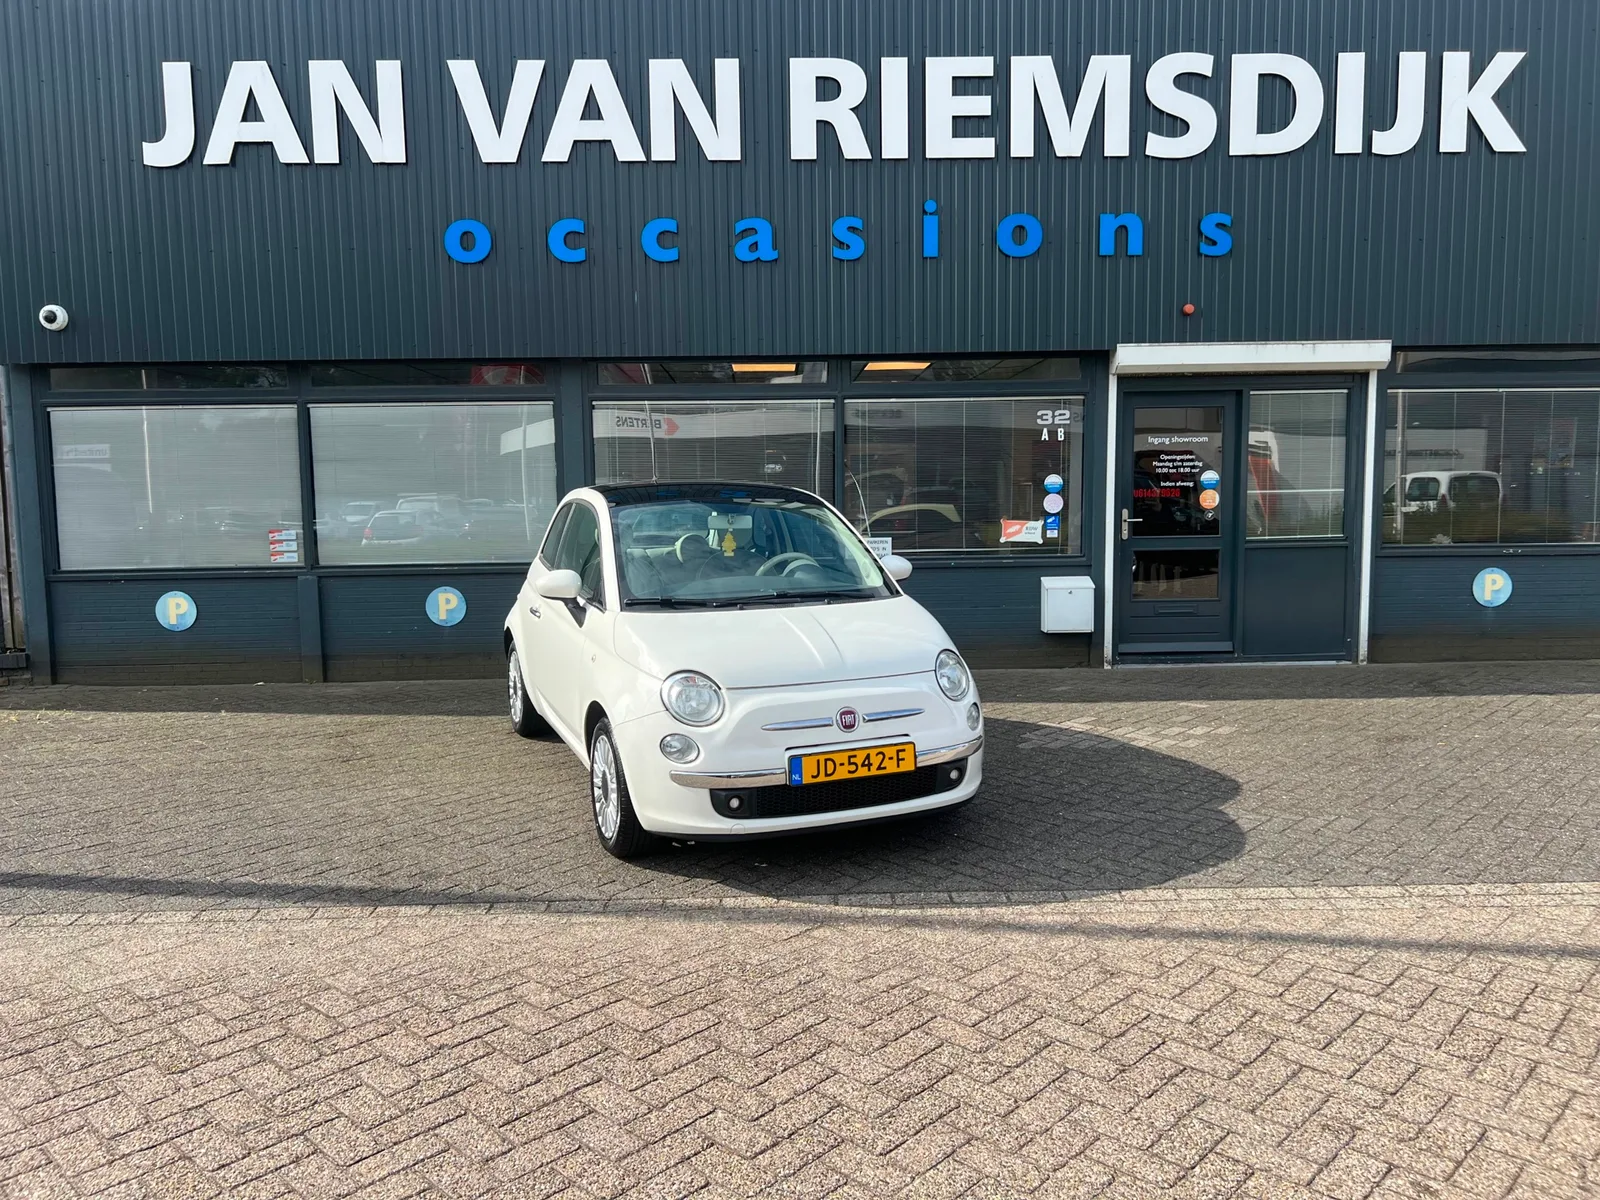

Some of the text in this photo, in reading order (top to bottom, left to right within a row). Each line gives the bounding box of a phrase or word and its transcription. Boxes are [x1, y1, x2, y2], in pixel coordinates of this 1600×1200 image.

[142, 50, 1527, 167] JAN VAN RIEMSDIJK
[443, 199, 1234, 264] occasions
[1036, 409, 1071, 425] 32
[1041, 427, 1065, 441] A B
[1148, 436, 1170, 445] Ingang
[1483, 573, 1504, 601] P
[167, 597, 188, 625] P
[438, 593, 458, 620] P
[841, 713, 855, 726] FIAT
[811, 748, 906, 779] JD-542-F
